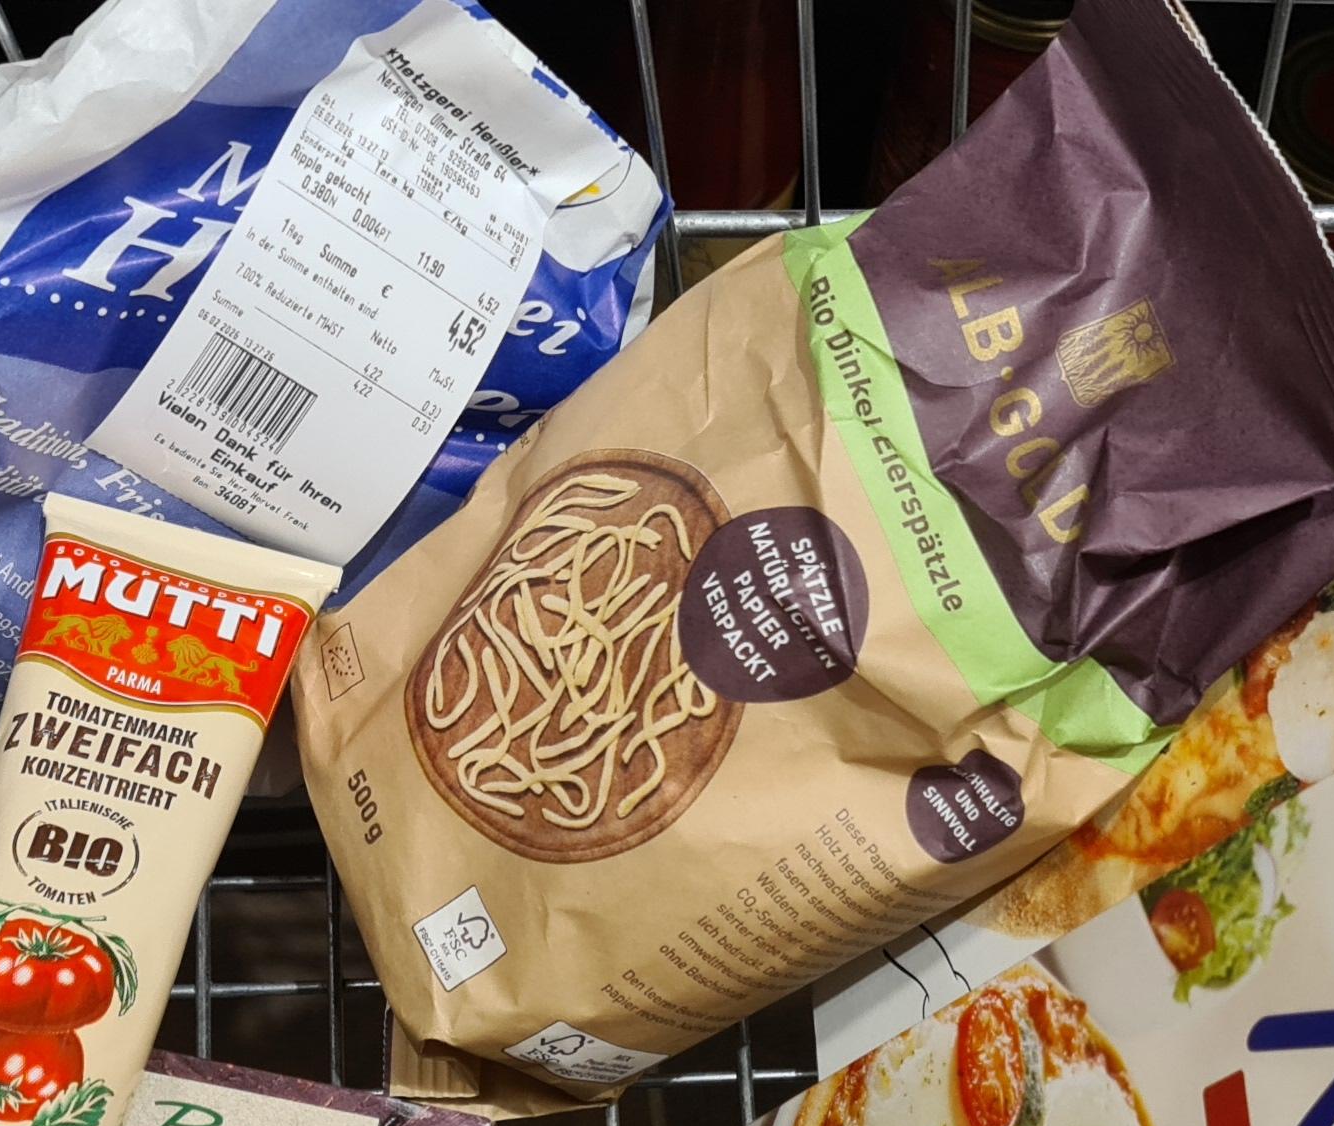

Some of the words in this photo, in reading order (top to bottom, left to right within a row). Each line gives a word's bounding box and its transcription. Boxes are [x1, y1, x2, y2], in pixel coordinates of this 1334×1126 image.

[299, 131, 348, 169] Sonderpreis
[378, 70, 424, 114] Nersingen
[430, 112, 457, 141] Ulmer
[460, 137, 493, 171] Straße
[494, 166, 507, 182] 64
[414, 123, 439, 148] 07308
[447, 150, 481, 181] 9299260
[290, 145, 324, 175] Ripple
[326, 169, 371, 205] gekocht
[425, 152, 438, 165] DE
[439, 162, 481, 199] 190585463
[259, 236, 275, 253] der
[276, 248, 311, 277] Summe
[311, 271, 357, 307] enthalten
[318, 244, 359, 279] Summe
[378, 283, 394, 300] €
[415, 252, 445, 279] 11,90
[475, 292, 500, 317] 4,52
[211, 290, 245, 319] Summe
[264, 283, 314, 321] Reduzierte
[315, 316, 344, 340] MWST
[370, 331, 399, 357] Netto
[810, 275, 836, 327] Bio
[825, 328, 882, 428] Dinkel
[156, 392, 209, 432] Vielen
[214, 427, 259, 463] Dank
[266, 458, 295, 485] für
[300, 480, 344, 514] Ihren
[169, 442, 208, 469] bediente
[228, 478, 247, 494] Herr
[210, 448, 277, 495] Einkauf
[214, 485, 255, 516] 34081
[56, 545, 120, 568] SOLO
[41, 558, 284, 659] MUTTI
[733, 570, 790, 651] PAPIER
[747, 522, 817, 641] NATÜRLICH
[814, 645, 837, 669] IN
[791, 537, 844, 637] SPÄTZLE
[701, 572, 777, 683] VERPACKT
[106, 665, 162, 695] PARMA
[46, 690, 199, 748] TOMATENMARK
[3, 711, 222, 800] ZWEIFACH
[21, 755, 177, 810] KONZENTRIERT
[953, 788, 980, 823] UND
[45, 797, 135, 831] ITALIENISCHE
[835, 808, 867, 848] Diese
[922, 784, 977, 854] SINNVOLL
[27, 823, 124, 877] BIO
[813, 825, 843, 858] Holz
[27, 875, 98, 906] TOMATEN
[754, 871, 804, 923] Wäldern,
[775, 857, 812, 897] fasern
[442, 927, 468, 961] FSC
[697, 915, 722, 939] lich
[716, 901, 755, 939] sierter
[621, 969, 647, 991] Den
[659, 942, 689, 970] ohne
